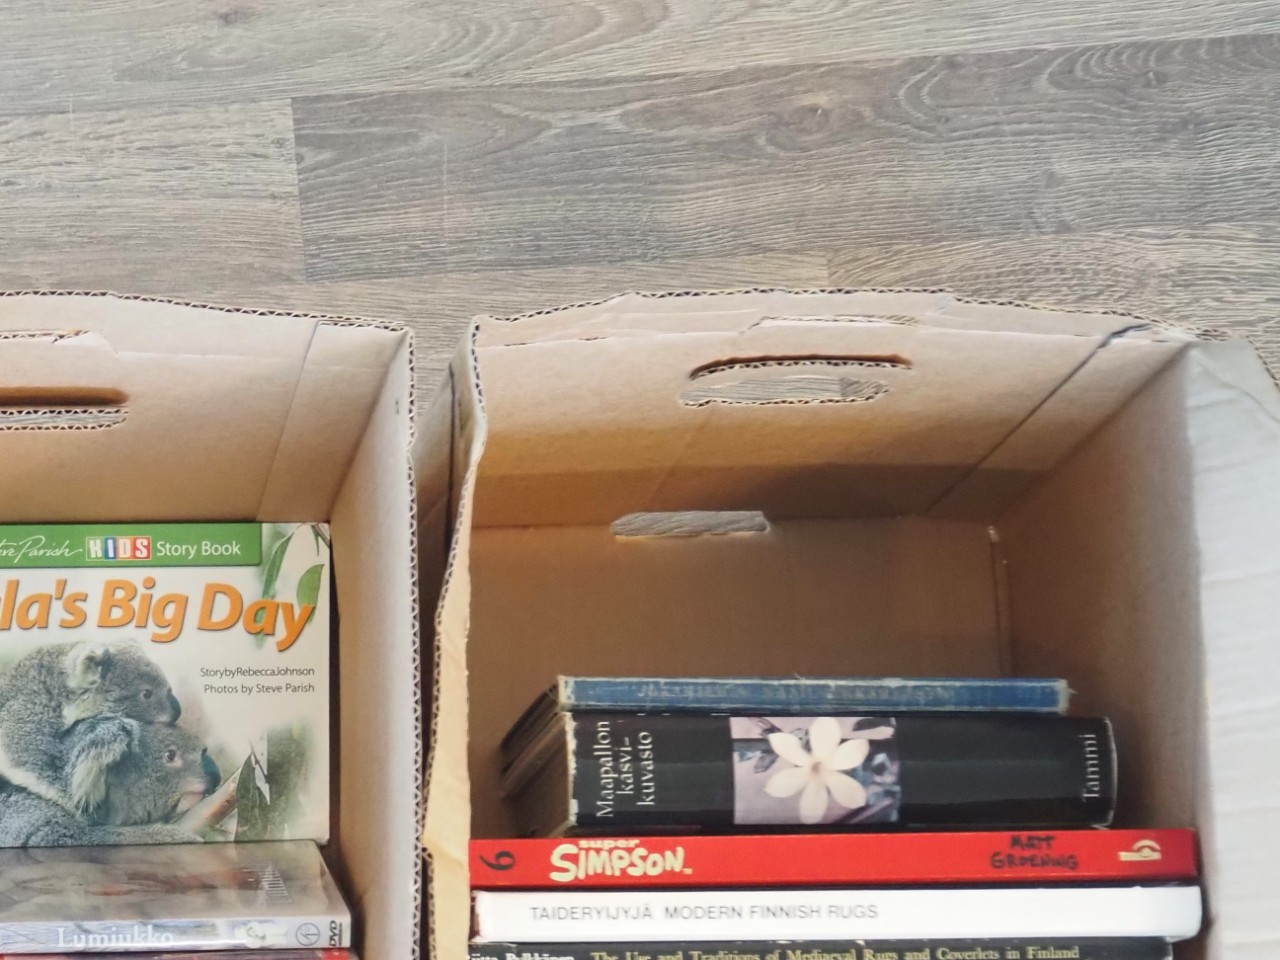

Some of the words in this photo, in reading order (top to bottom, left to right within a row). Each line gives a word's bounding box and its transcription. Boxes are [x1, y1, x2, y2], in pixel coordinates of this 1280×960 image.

[13, 535, 83, 563] Parish
[87, 537, 152, 560] KIDS
[157, 540, 198, 561] Story
[202, 540, 241, 556] Book
[97, 576, 189, 643] Big
[197, 582, 316, 652] Day
[204, 683, 238, 694] Photos
[241, 683, 253, 696] by
[256, 683, 282, 694] Steve
[285, 682, 315, 693] Parish
[592, 720, 615, 818] Maapallon
[616, 736, 635, 795] kasvi-
[636, 731, 656, 806] kuvasto
[1078, 734, 1100, 803] Tammi
[549, 843, 686, 882] SIMPSON
[990, 852, 1080, 870] GROENING
[530, 904, 654, 921] TAIDERYIJYJÄ
[665, 905, 743, 920] MODERN
[749, 904, 821, 919] FINNISH
[828, 904, 879, 919] RUGS
[903, 947, 930, 960] and
[935, 947, 1000, 960] Coverlets
[1005, 946, 1020, 960] in
[1026, 945, 1080, 960] Finland
